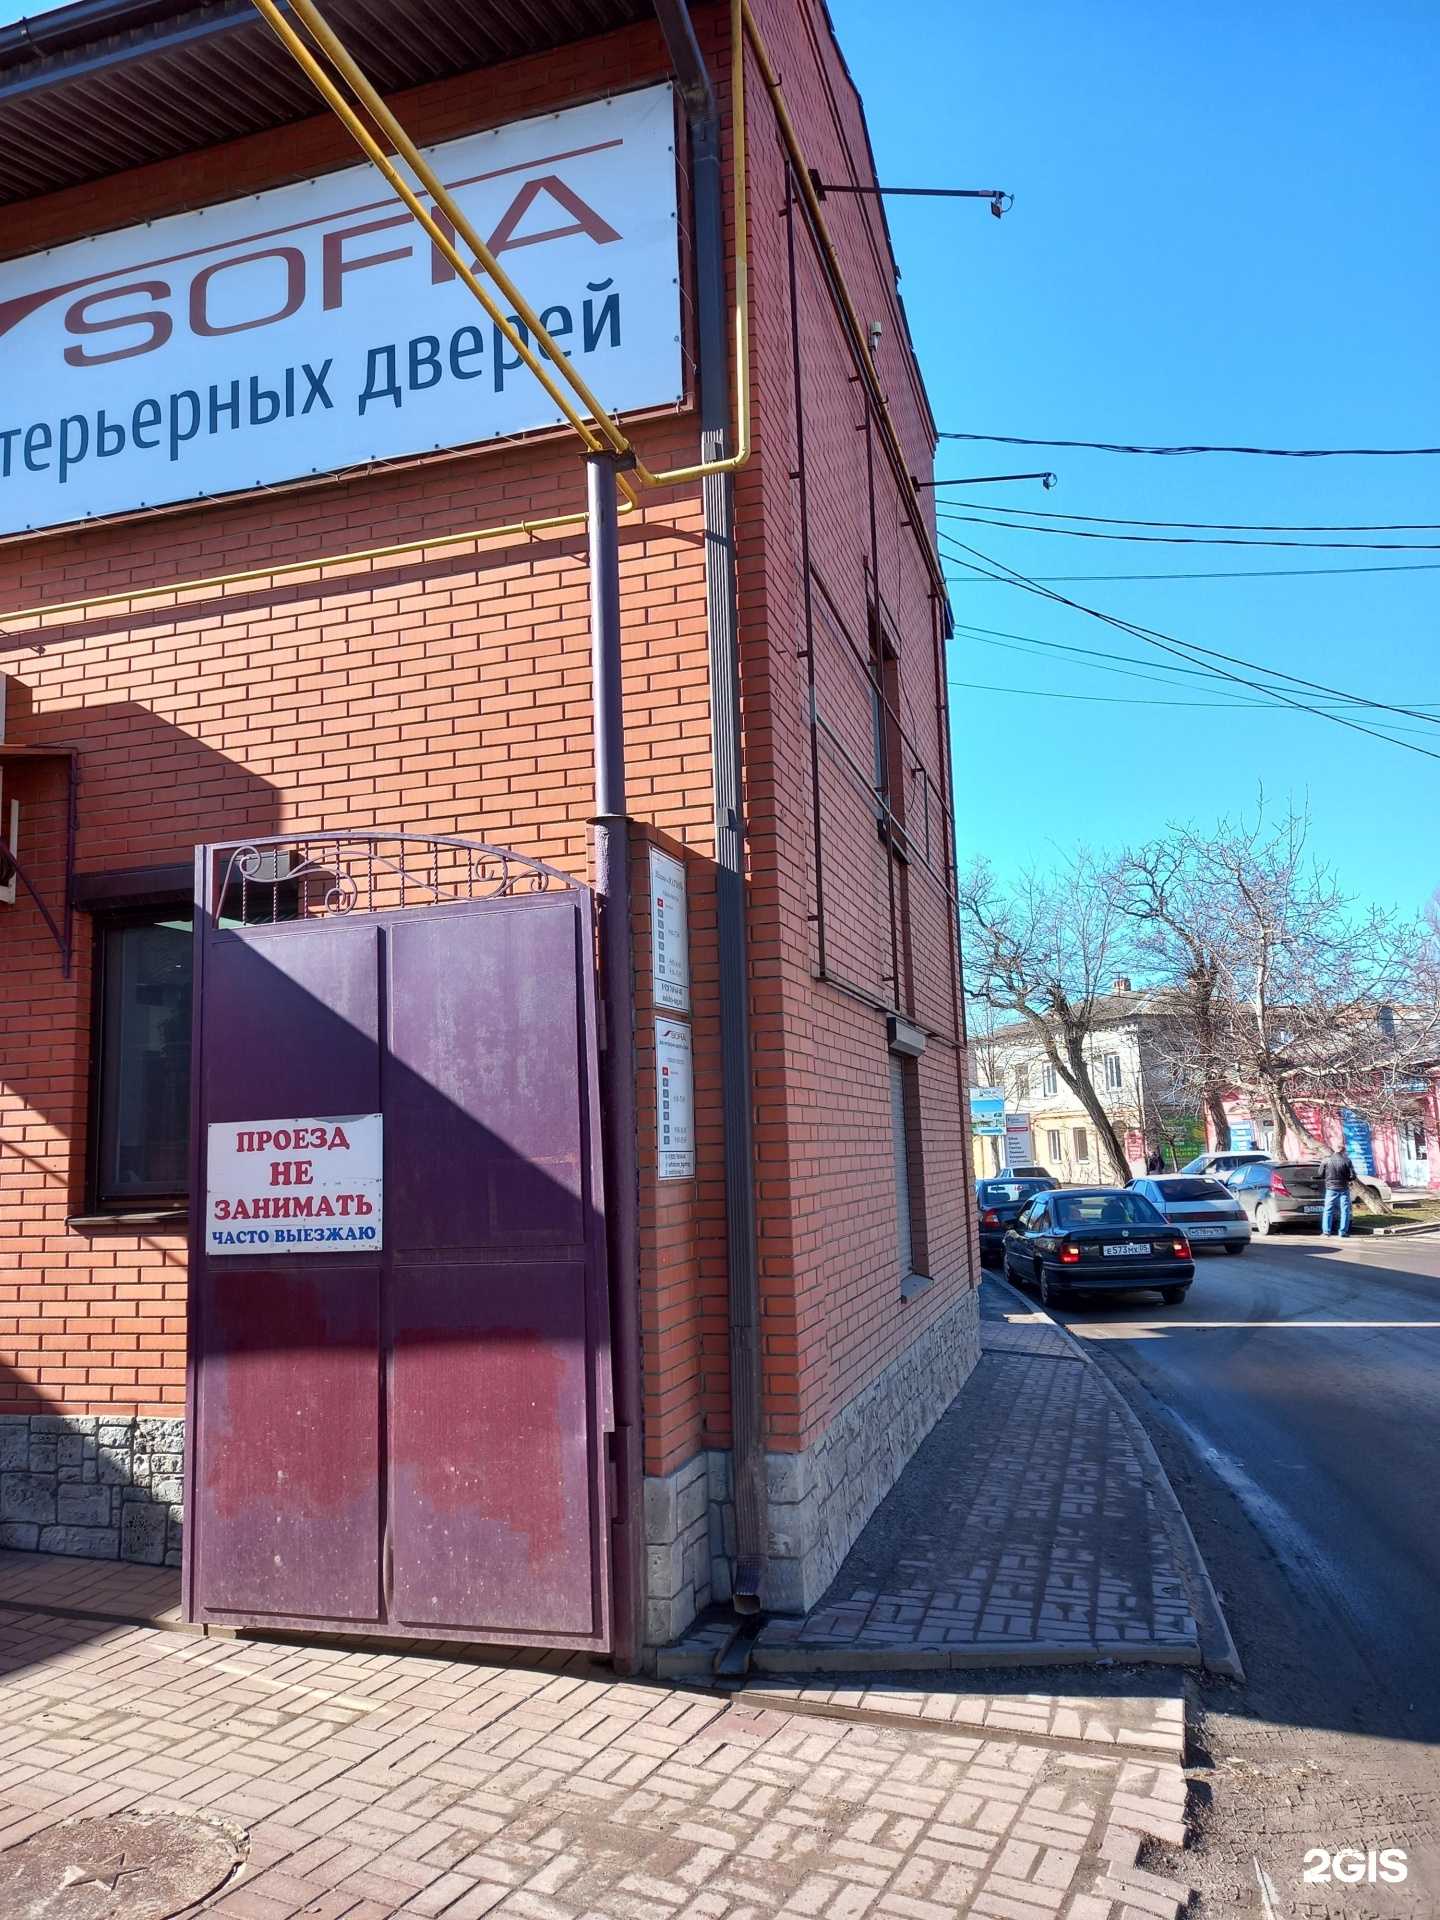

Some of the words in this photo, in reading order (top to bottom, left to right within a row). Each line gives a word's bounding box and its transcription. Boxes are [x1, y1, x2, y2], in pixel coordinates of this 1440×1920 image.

[64, 175, 623, 367] SOFIA
[0, 358, 334, 484] терьерных
[358, 277, 621, 416] дверей
[236, 1126, 350, 1153] ПРОЕЗД
[270, 1160, 314, 1186] НЕ
[214, 1194, 373, 1221] ЗАНИМАТЬ
[212, 1230, 270, 1245] ЧАСТО
[274, 1226, 376, 1243] ВЫЕЗЖАЮ
